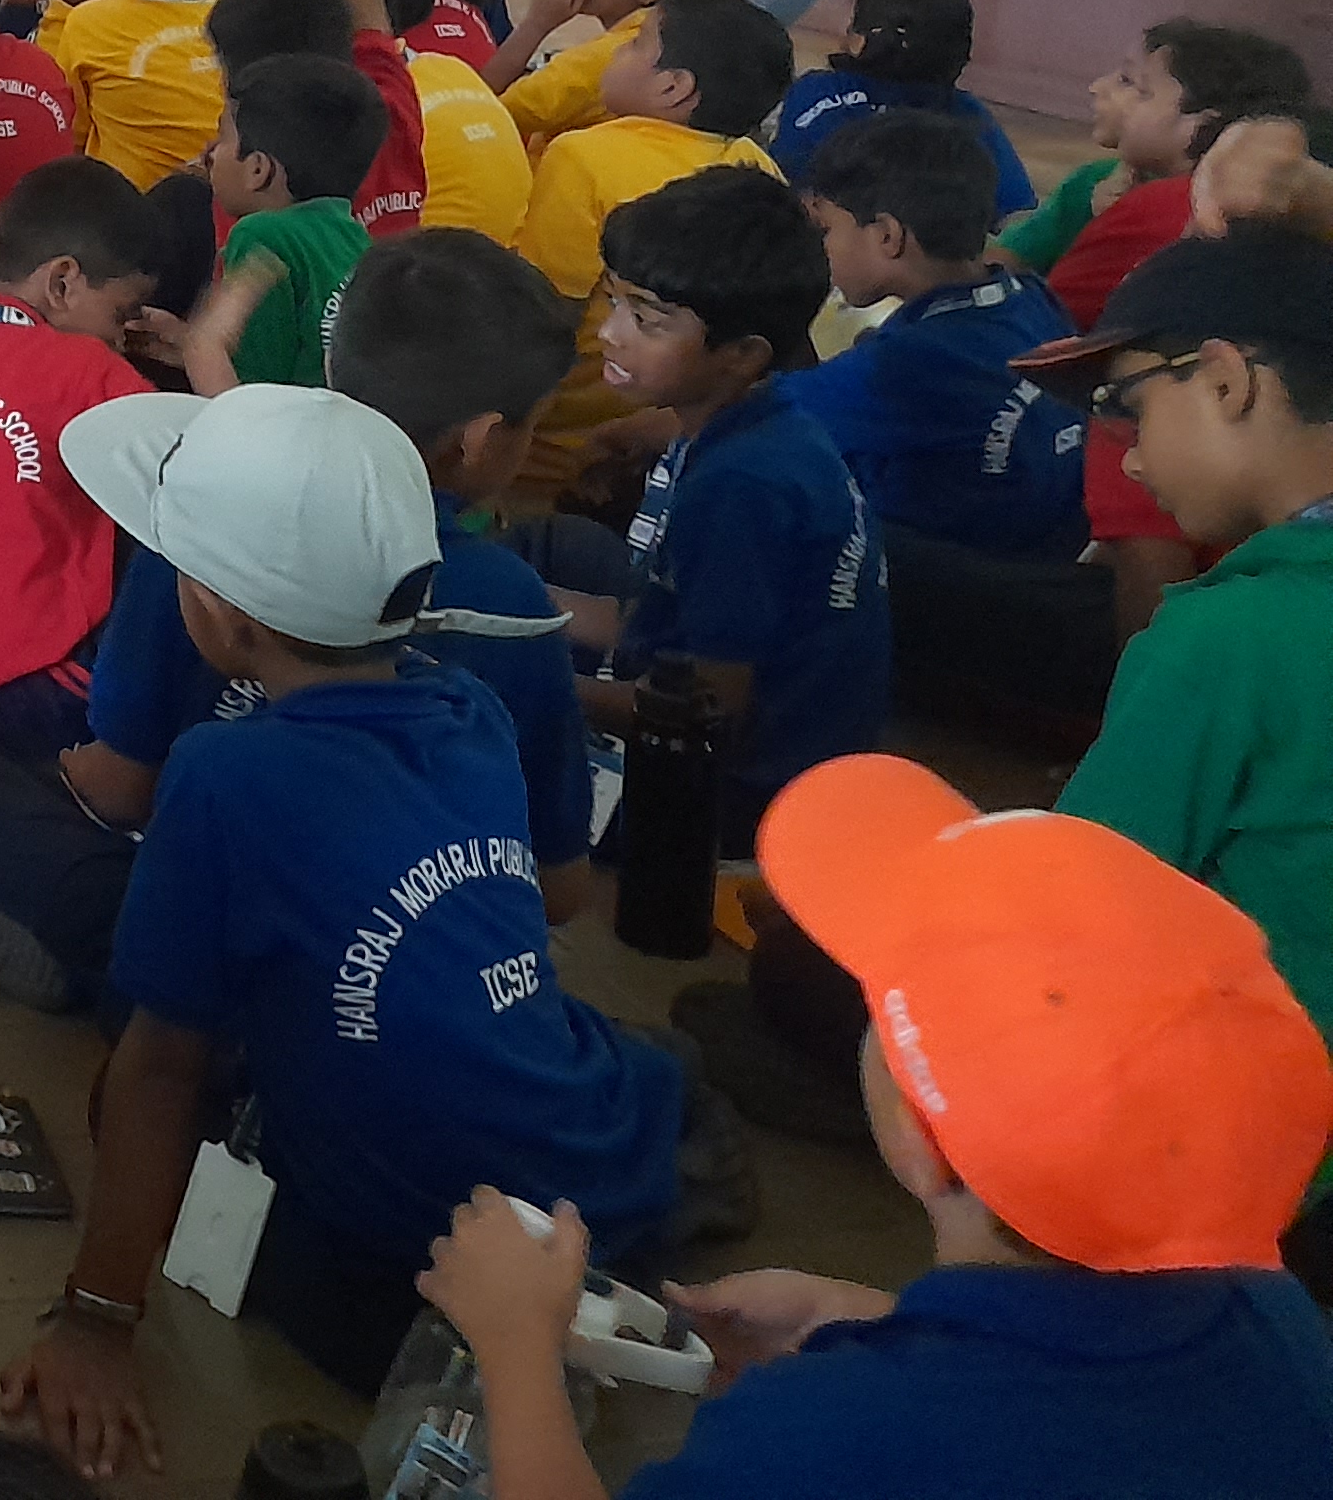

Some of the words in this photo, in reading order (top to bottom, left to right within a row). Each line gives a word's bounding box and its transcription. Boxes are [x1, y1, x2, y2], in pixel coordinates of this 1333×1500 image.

[375, 190, 423, 217] PUBLIC
[332, 905, 405, 1043] HANSRAJ
[389, 836, 488, 922] MORARJI
[478, 950, 540, 1014] ICSE
